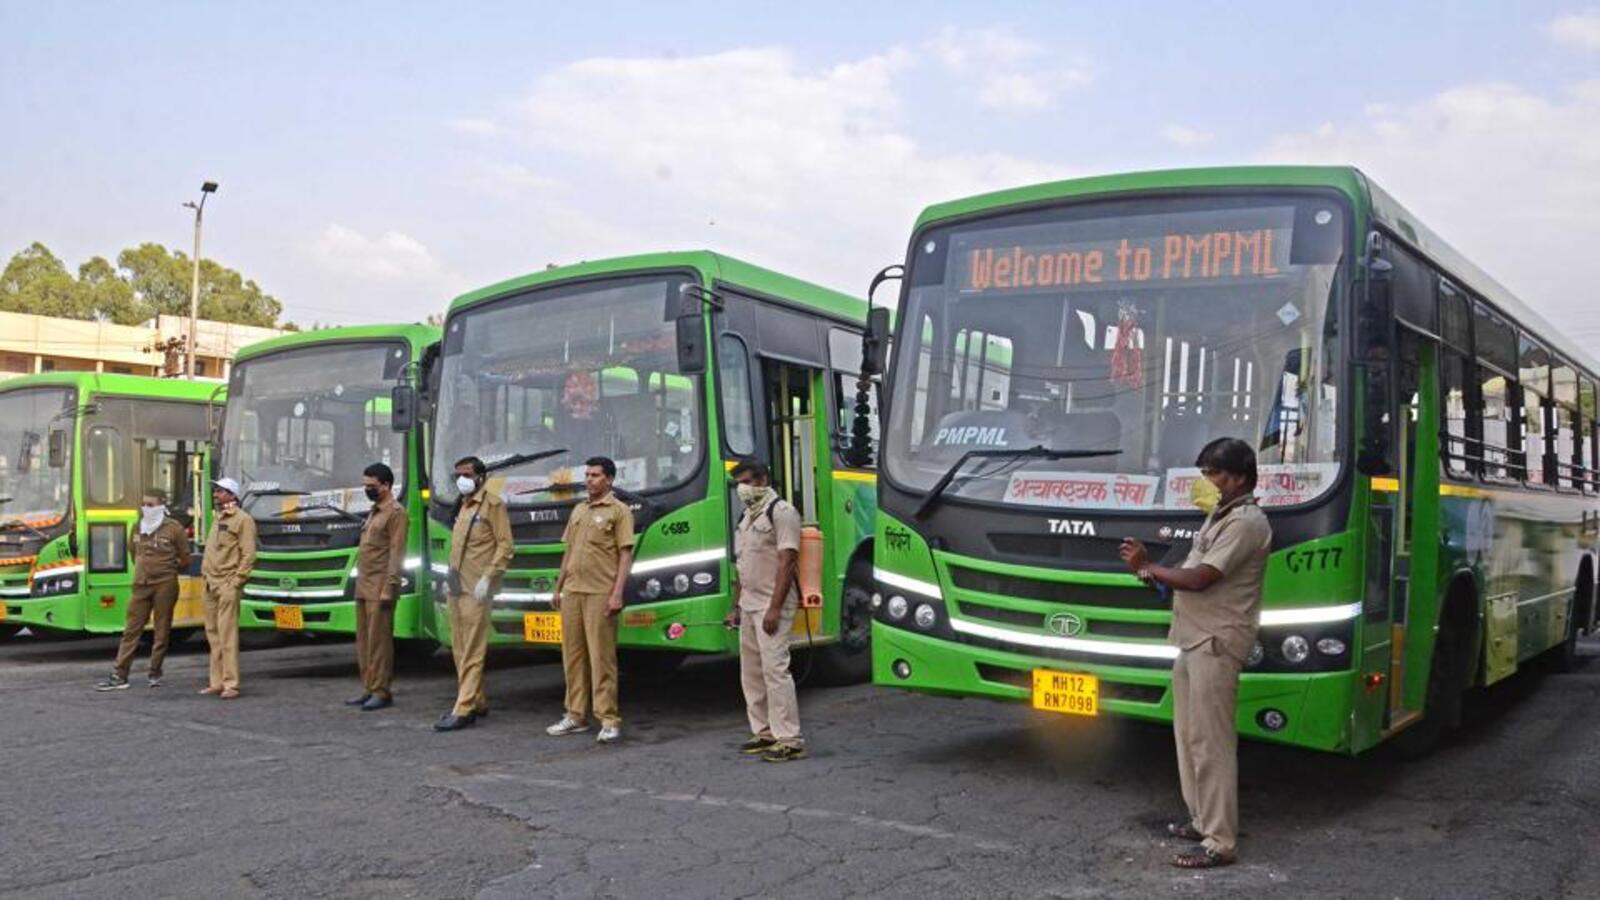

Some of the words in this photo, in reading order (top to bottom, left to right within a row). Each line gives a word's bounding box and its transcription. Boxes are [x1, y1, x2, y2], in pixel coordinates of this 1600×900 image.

[970, 245, 1104, 289] Welcome
[1115, 239, 1151, 281] to
[1162, 228, 1279, 279] PMPML
[934, 426, 1009, 446] PMPML
[1114, 472, 1149, 506] सेवा
[529, 510, 559, 521] TATA
[1048, 519, 1096, 536] TATA
[1052, 675, 1085, 693] MH12
[1044, 693, 1093, 712] RN7098
